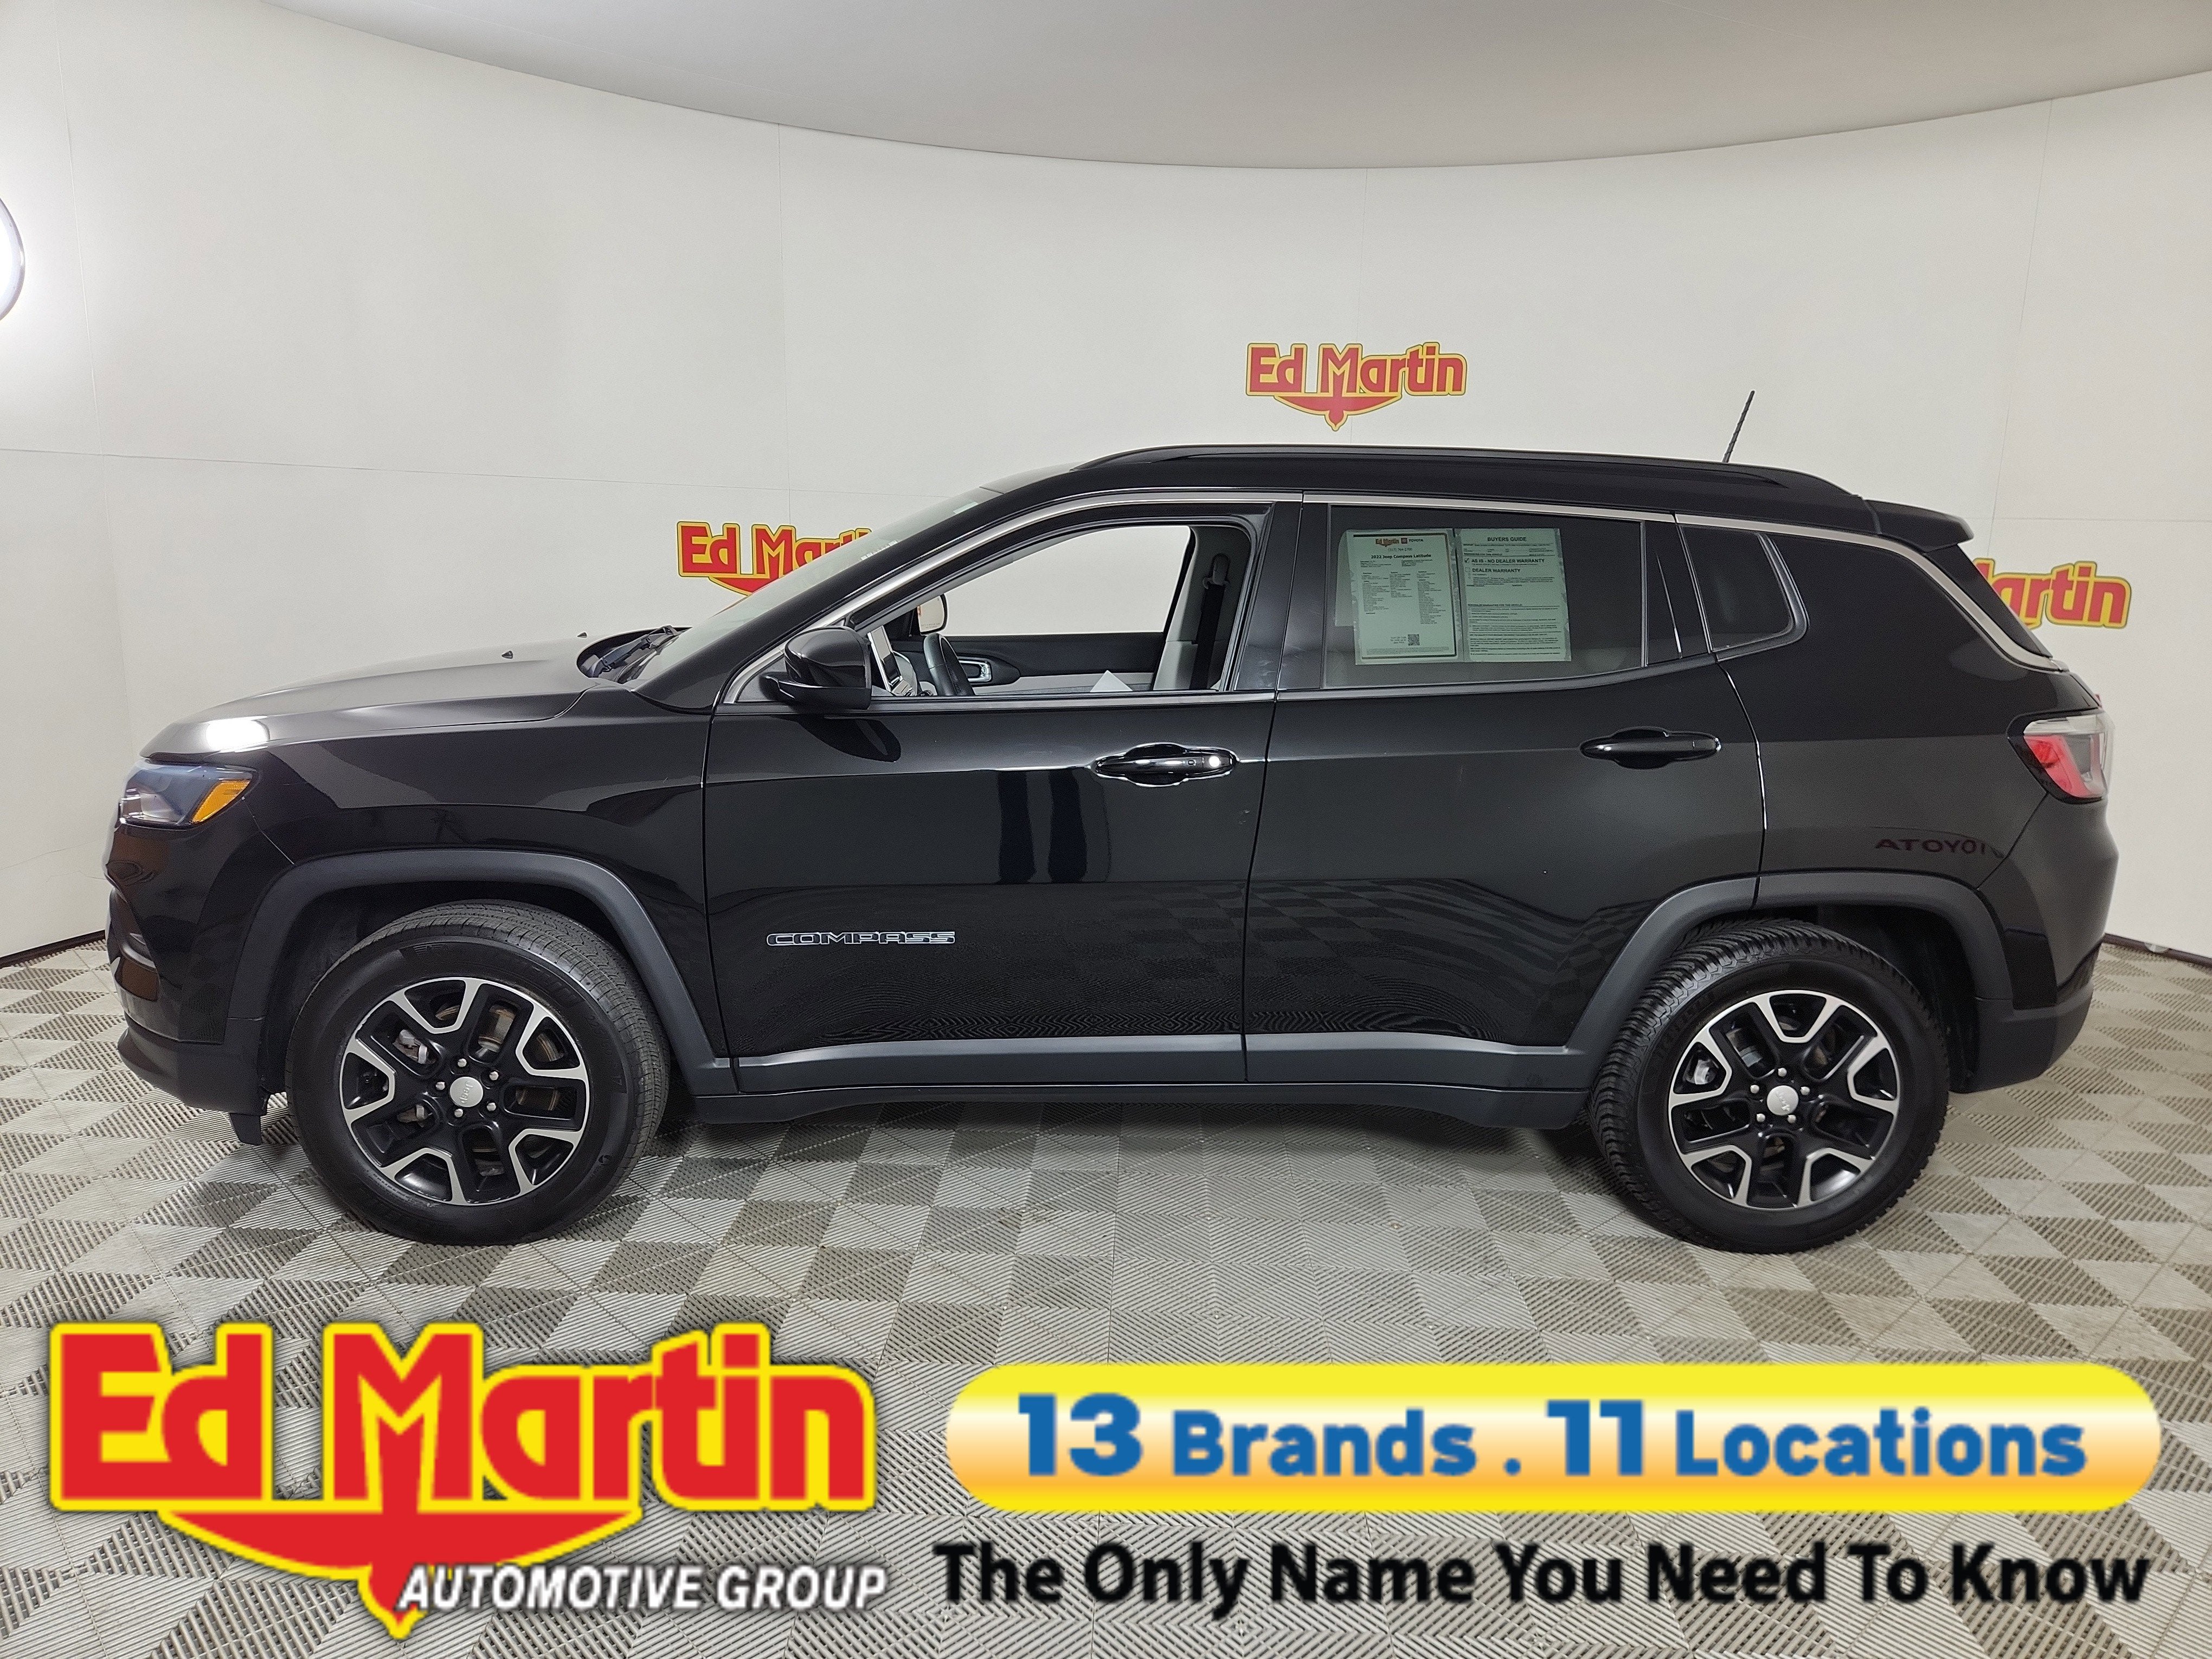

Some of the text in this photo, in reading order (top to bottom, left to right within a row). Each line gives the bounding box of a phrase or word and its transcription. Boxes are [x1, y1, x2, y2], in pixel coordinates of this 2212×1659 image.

[1247, 343, 1467, 396] Ed Martin
[677, 522, 740, 577] Ed
[1973, 557, 2131, 629] artin
[766, 931, 955, 946] COMPASS
